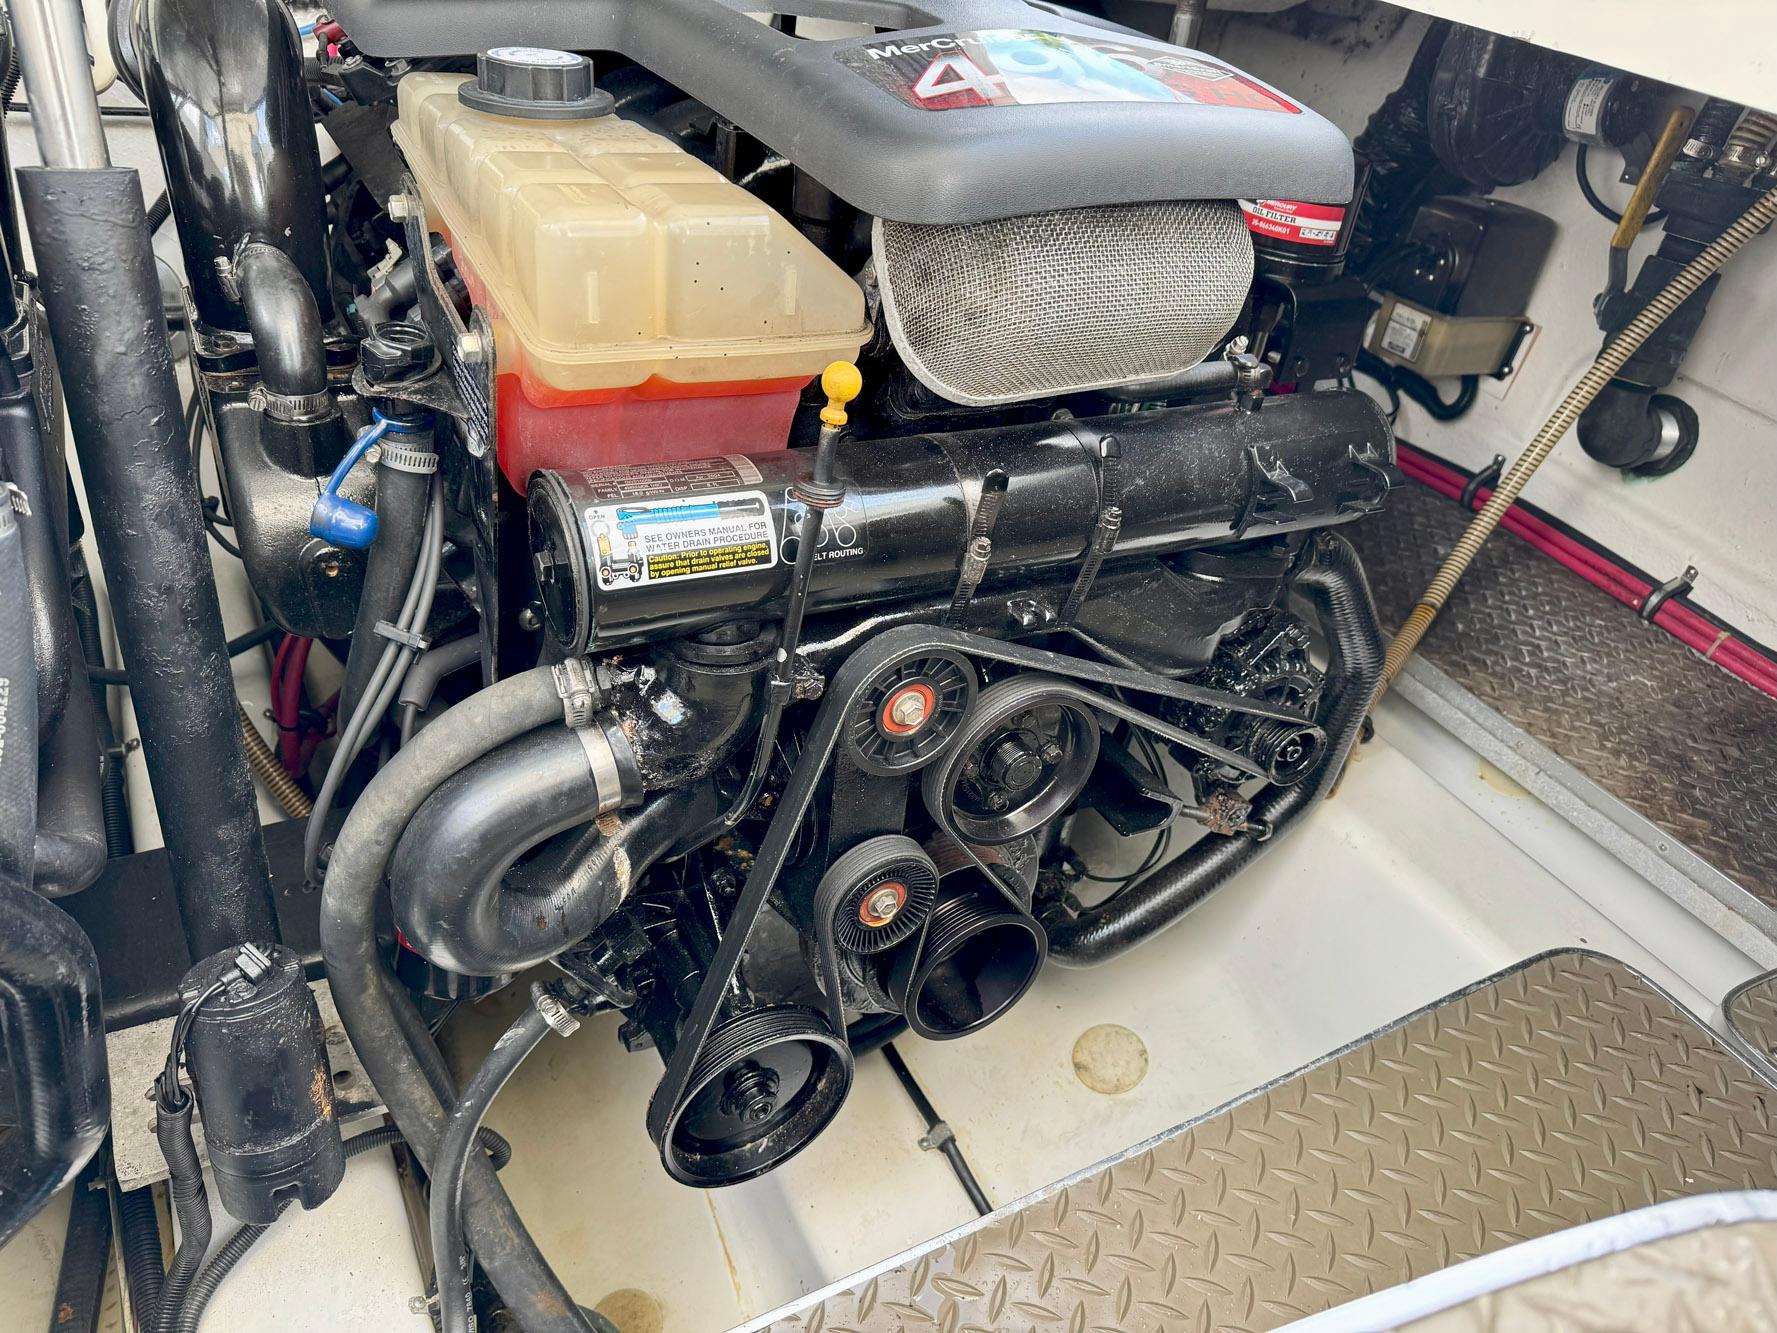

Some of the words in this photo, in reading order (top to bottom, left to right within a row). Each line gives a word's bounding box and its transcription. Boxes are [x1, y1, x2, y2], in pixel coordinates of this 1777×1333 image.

[1252, 206, 1264, 217] OIL
[1265, 210, 1297, 224] FILTER
[644, 533, 664, 543] SEE
[665, 529, 707, 541] OWNERS
[708, 524, 747, 536] MANUAL
[748, 521, 767, 531] FOR
[646, 542, 681, 553] WATER
[682, 537, 712, 549] DRAIN
[713, 530, 769, 544] PROCEDURE
[648, 554, 680, 563] Caution:
[681, 551, 700, 559] Prior
[709, 546, 742, 556] operating
[675, 559, 691, 567] that
[691, 557, 710, 565] drain
[710, 554, 734, 562] valves
[746, 549, 769, 557] closed
[814, 551, 827, 560] ELT
[828, 547, 864, 559] ROUTING
[661, 565, 691, 575] opening
[718, 559, 738, 567] relief
